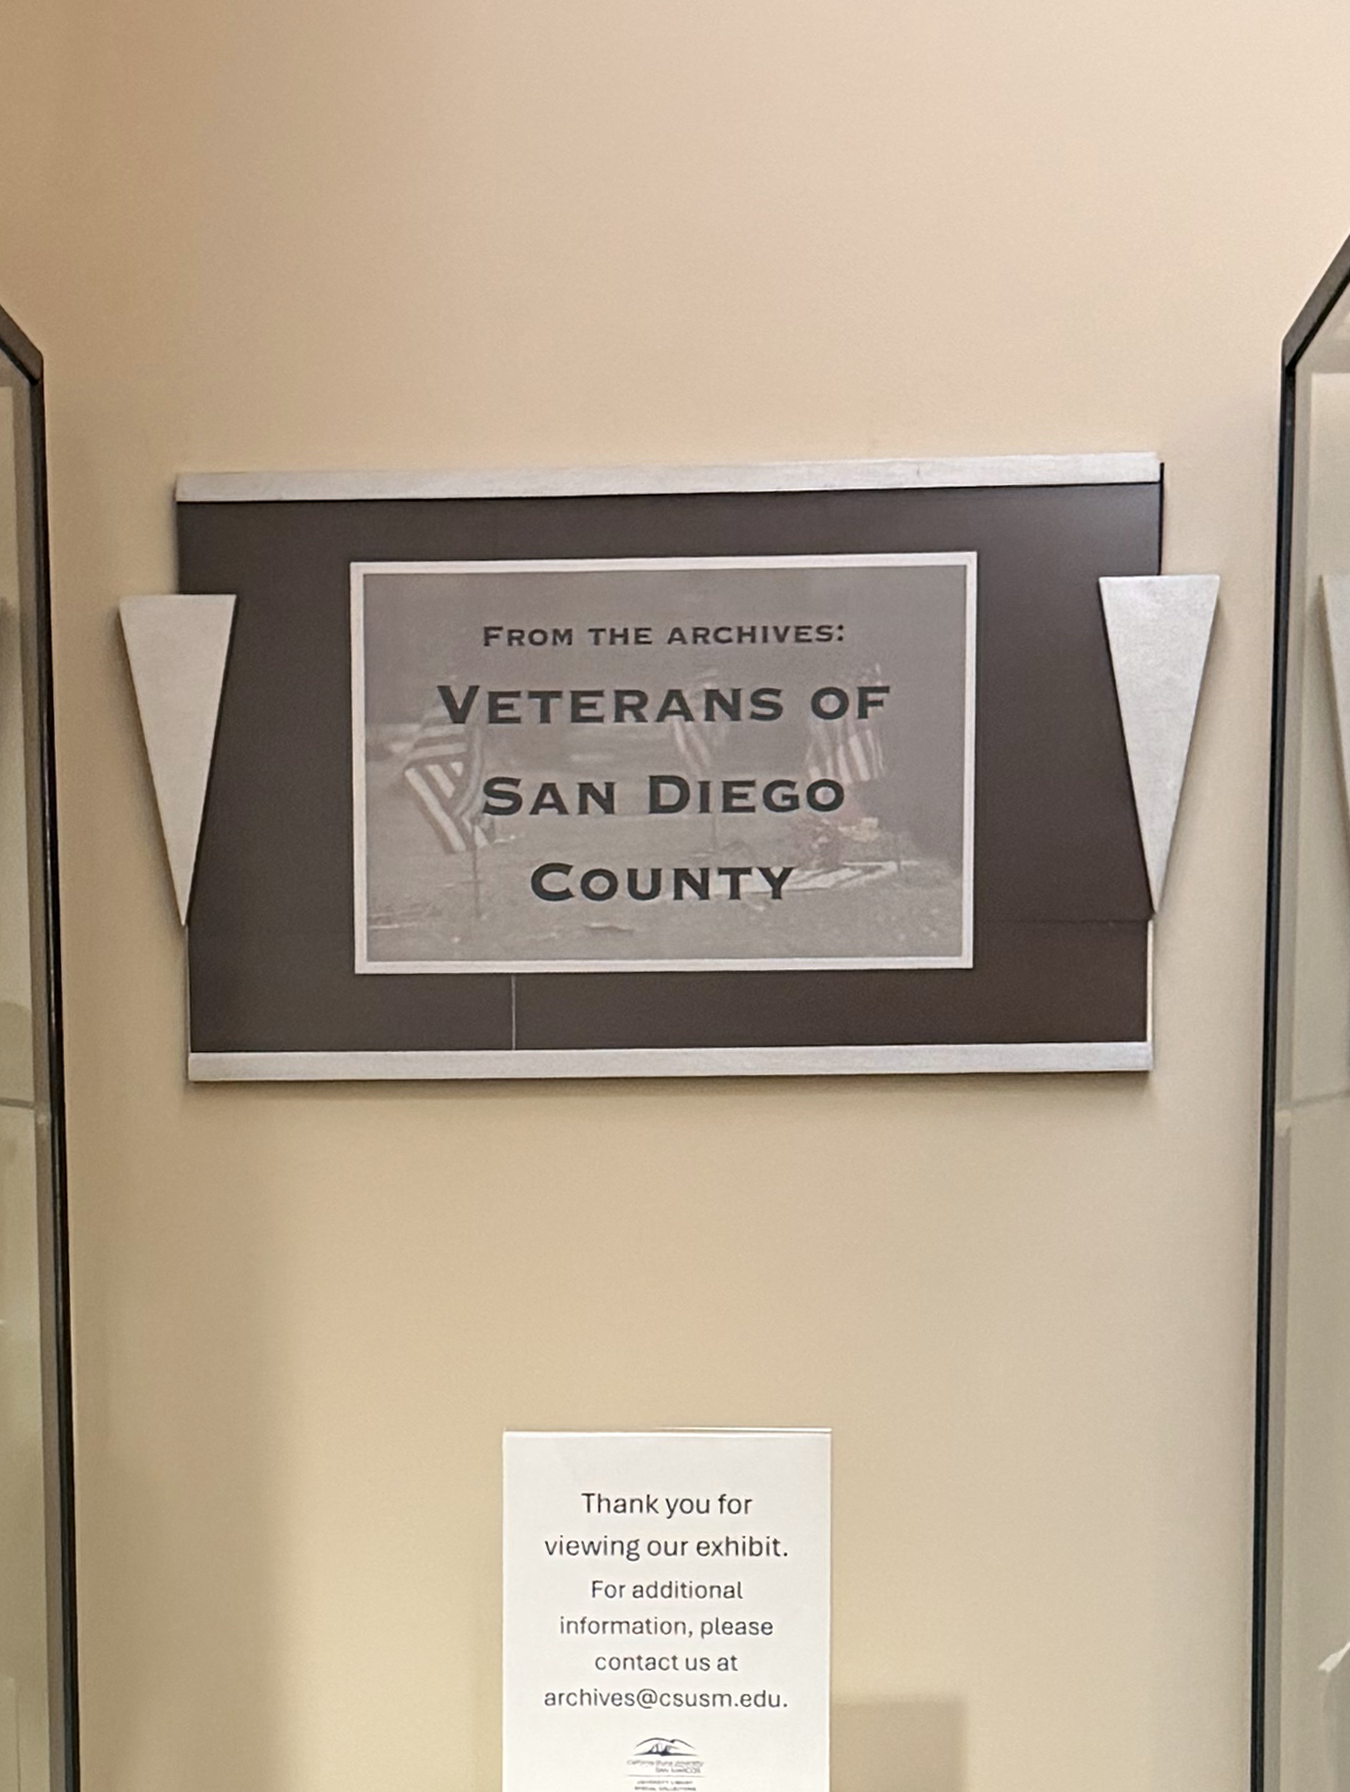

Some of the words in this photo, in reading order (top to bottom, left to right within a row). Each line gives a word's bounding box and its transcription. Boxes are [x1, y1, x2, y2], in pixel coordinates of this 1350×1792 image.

[482, 624, 574, 647] FROM
[589, 626, 653, 645] THE
[667, 623, 846, 645] ARCHIVES:
[437, 685, 784, 725] VETERANS
[810, 684, 890, 720] OF
[481, 776, 616, 816] SAN
[648, 774, 845, 813] DIEGO
[530, 864, 794, 901] COUNTY
[581, 1492, 659, 1515] Thank
[666, 1497, 710, 1518] you
[718, 1493, 753, 1515] for
[544, 1537, 640, 1560] viewing
[647, 1541, 688, 1557] our
[696, 1537, 789, 1557] exhibit.
[590, 1581, 626, 1599] For
[632, 1580, 743, 1600] additional
[560, 1617, 694, 1638] information,
[701, 1617, 774, 1639] please
[595, 1655, 679, 1672] contact
[685, 1658, 711, 1672] us
[716, 1655, 738, 1672] at
[544, 1689, 789, 1709] archives@csusm.edu.
